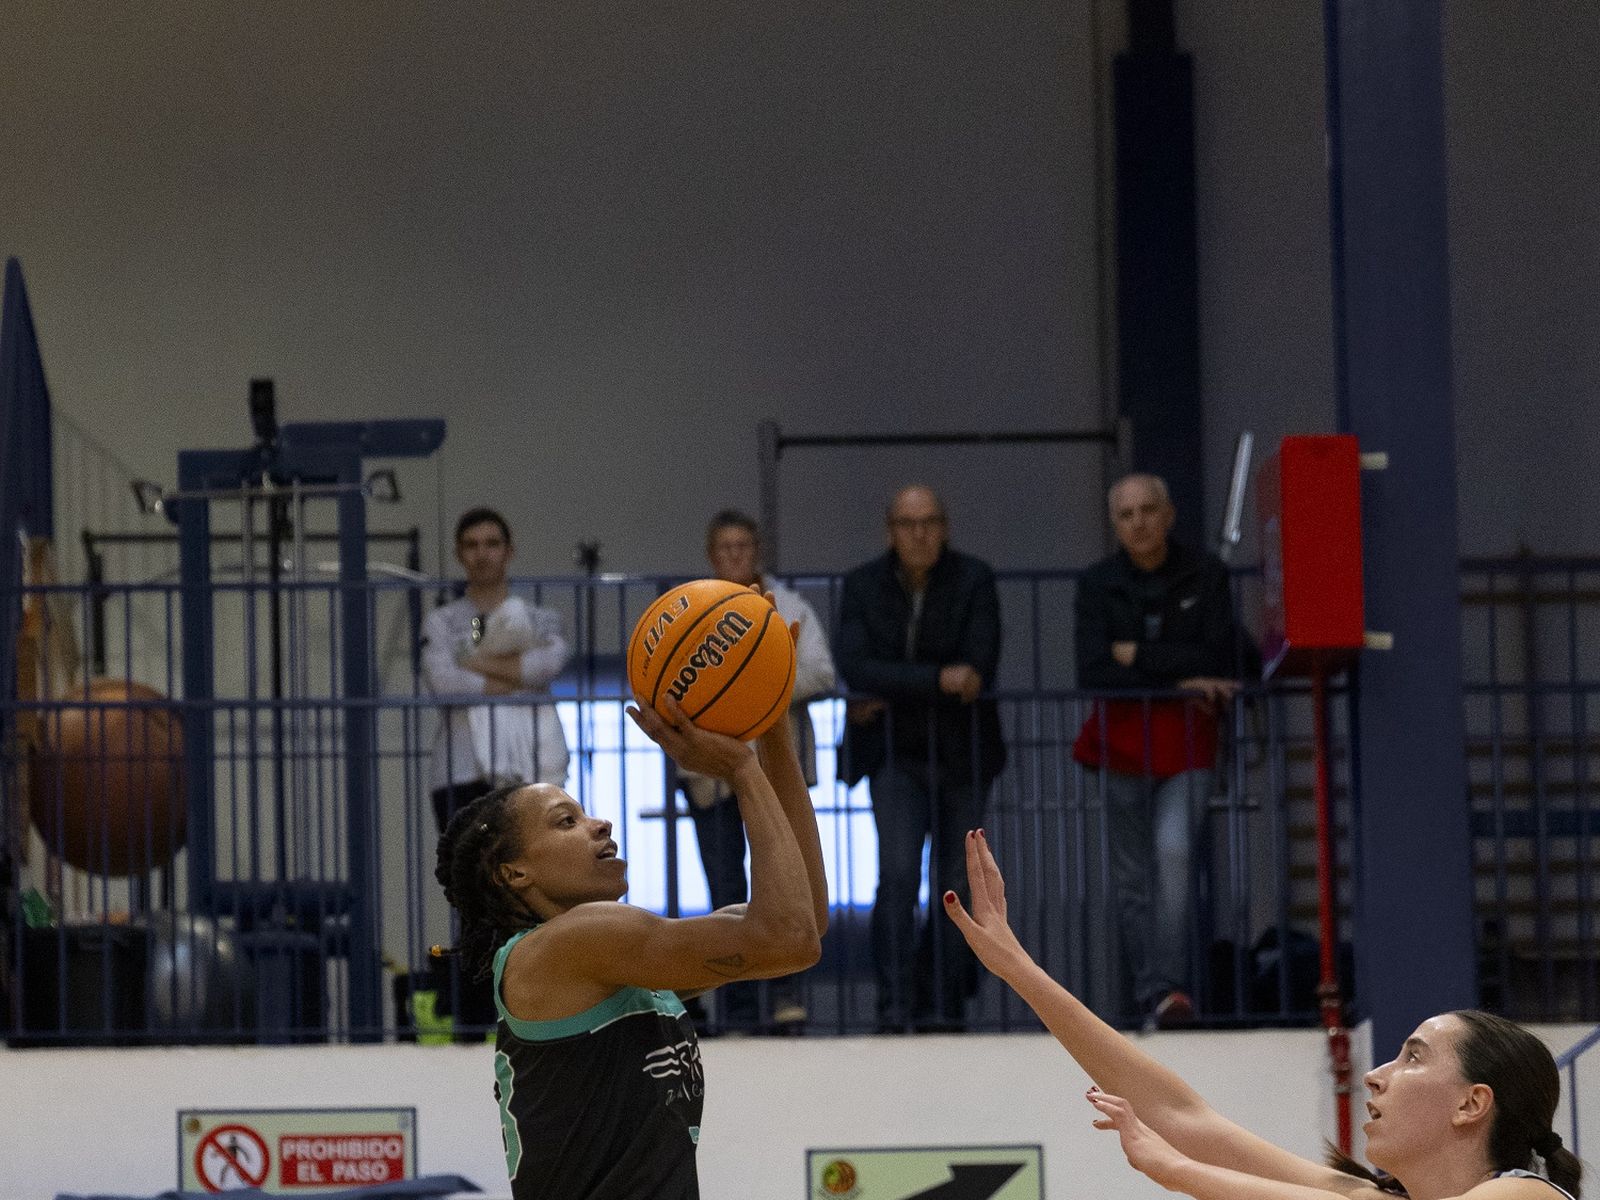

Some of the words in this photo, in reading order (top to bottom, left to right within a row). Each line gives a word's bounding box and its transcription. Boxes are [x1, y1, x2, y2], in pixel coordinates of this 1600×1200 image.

[643, 595, 690, 656] EVO
[664, 610, 753, 701] Wilson
[281, 1137, 402, 1160] PROHIBIDO
[296, 1161, 324, 1182] EL
[332, 1160, 390, 1182] PASO
